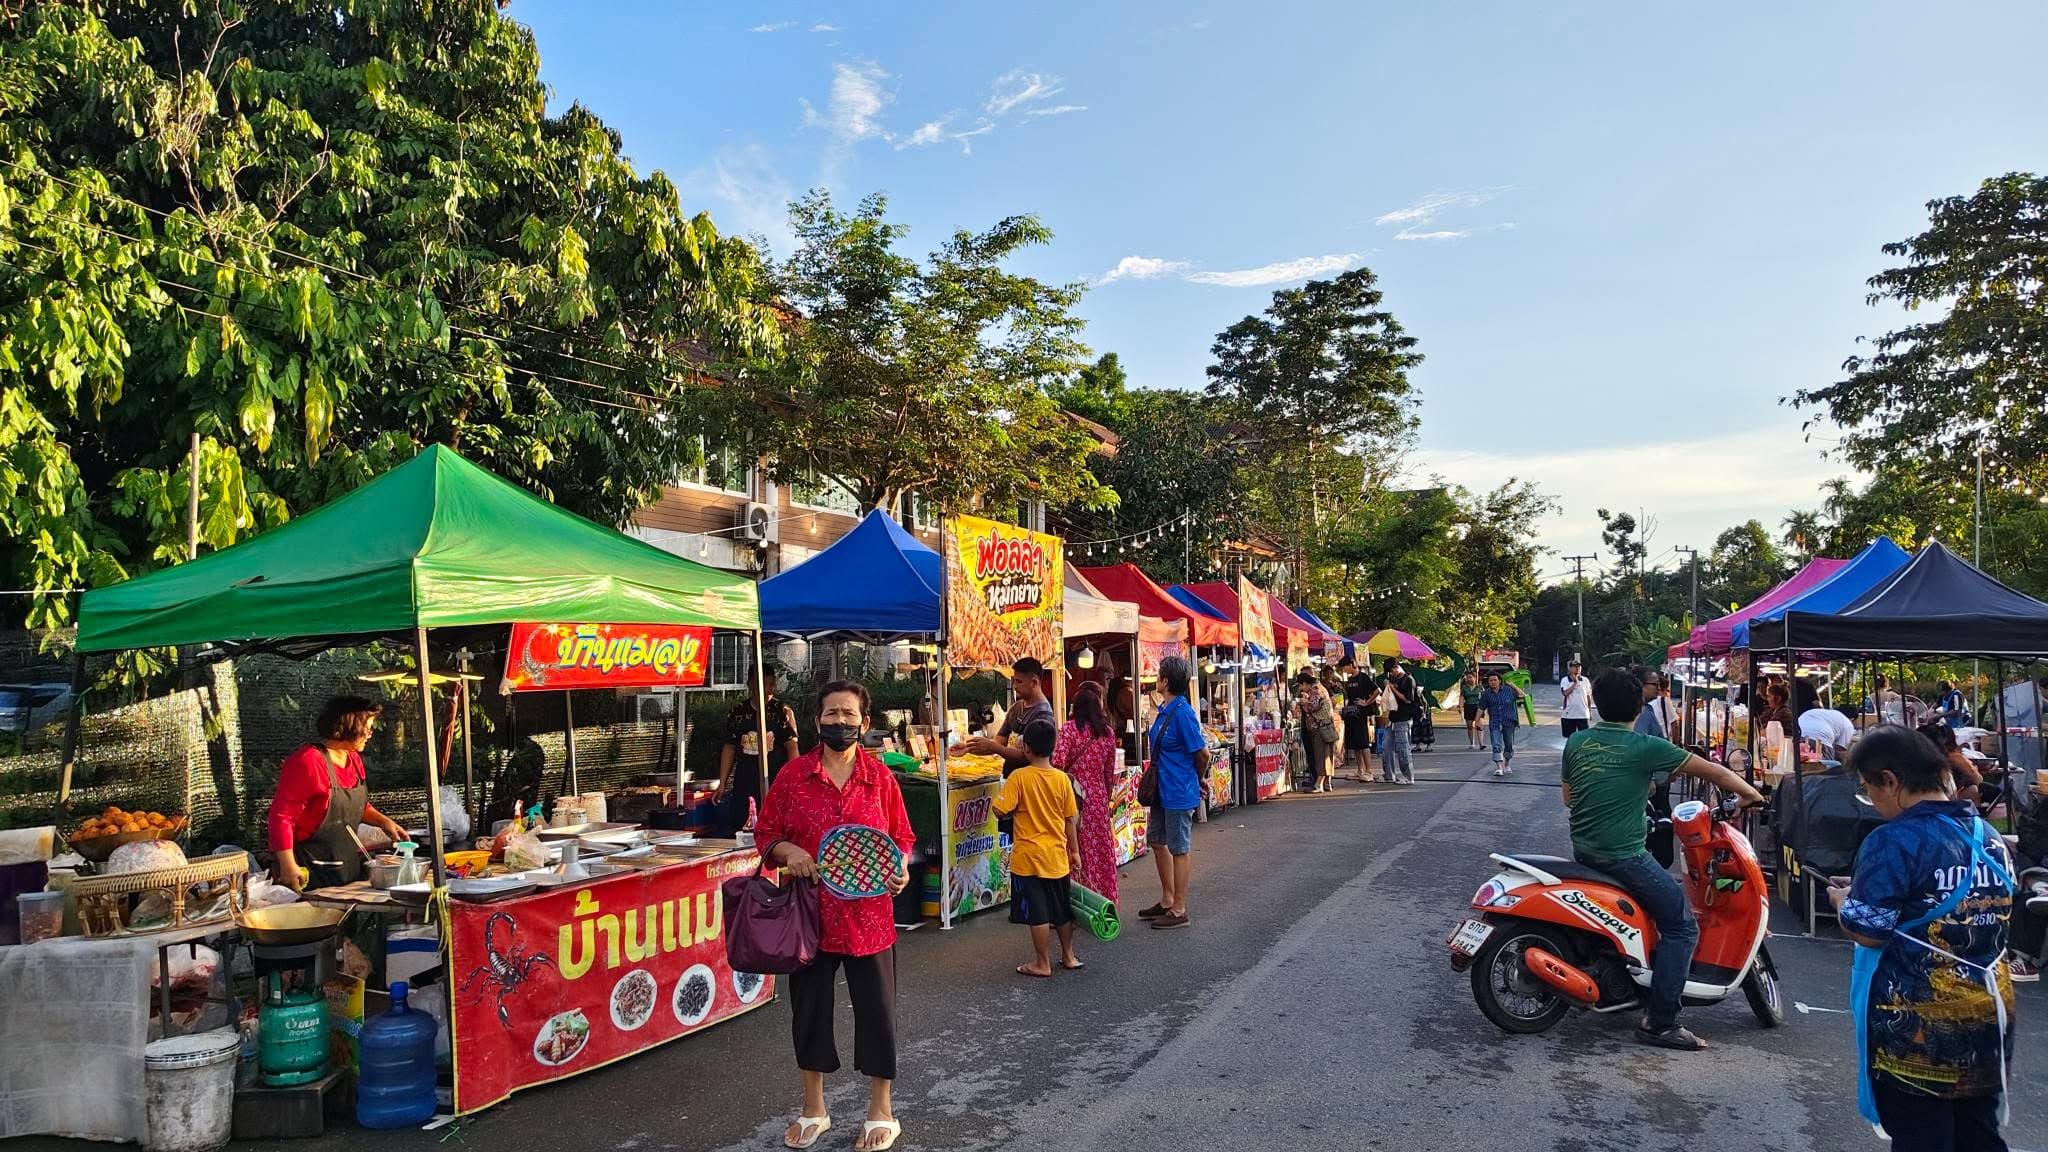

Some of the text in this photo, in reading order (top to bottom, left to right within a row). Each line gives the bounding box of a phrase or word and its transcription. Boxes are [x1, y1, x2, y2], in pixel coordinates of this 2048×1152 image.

[557, 624, 700, 675] บ้านแมลง
[558, 888, 724, 980] บ้านแม
[1973, 912, 1996, 926] 2510
